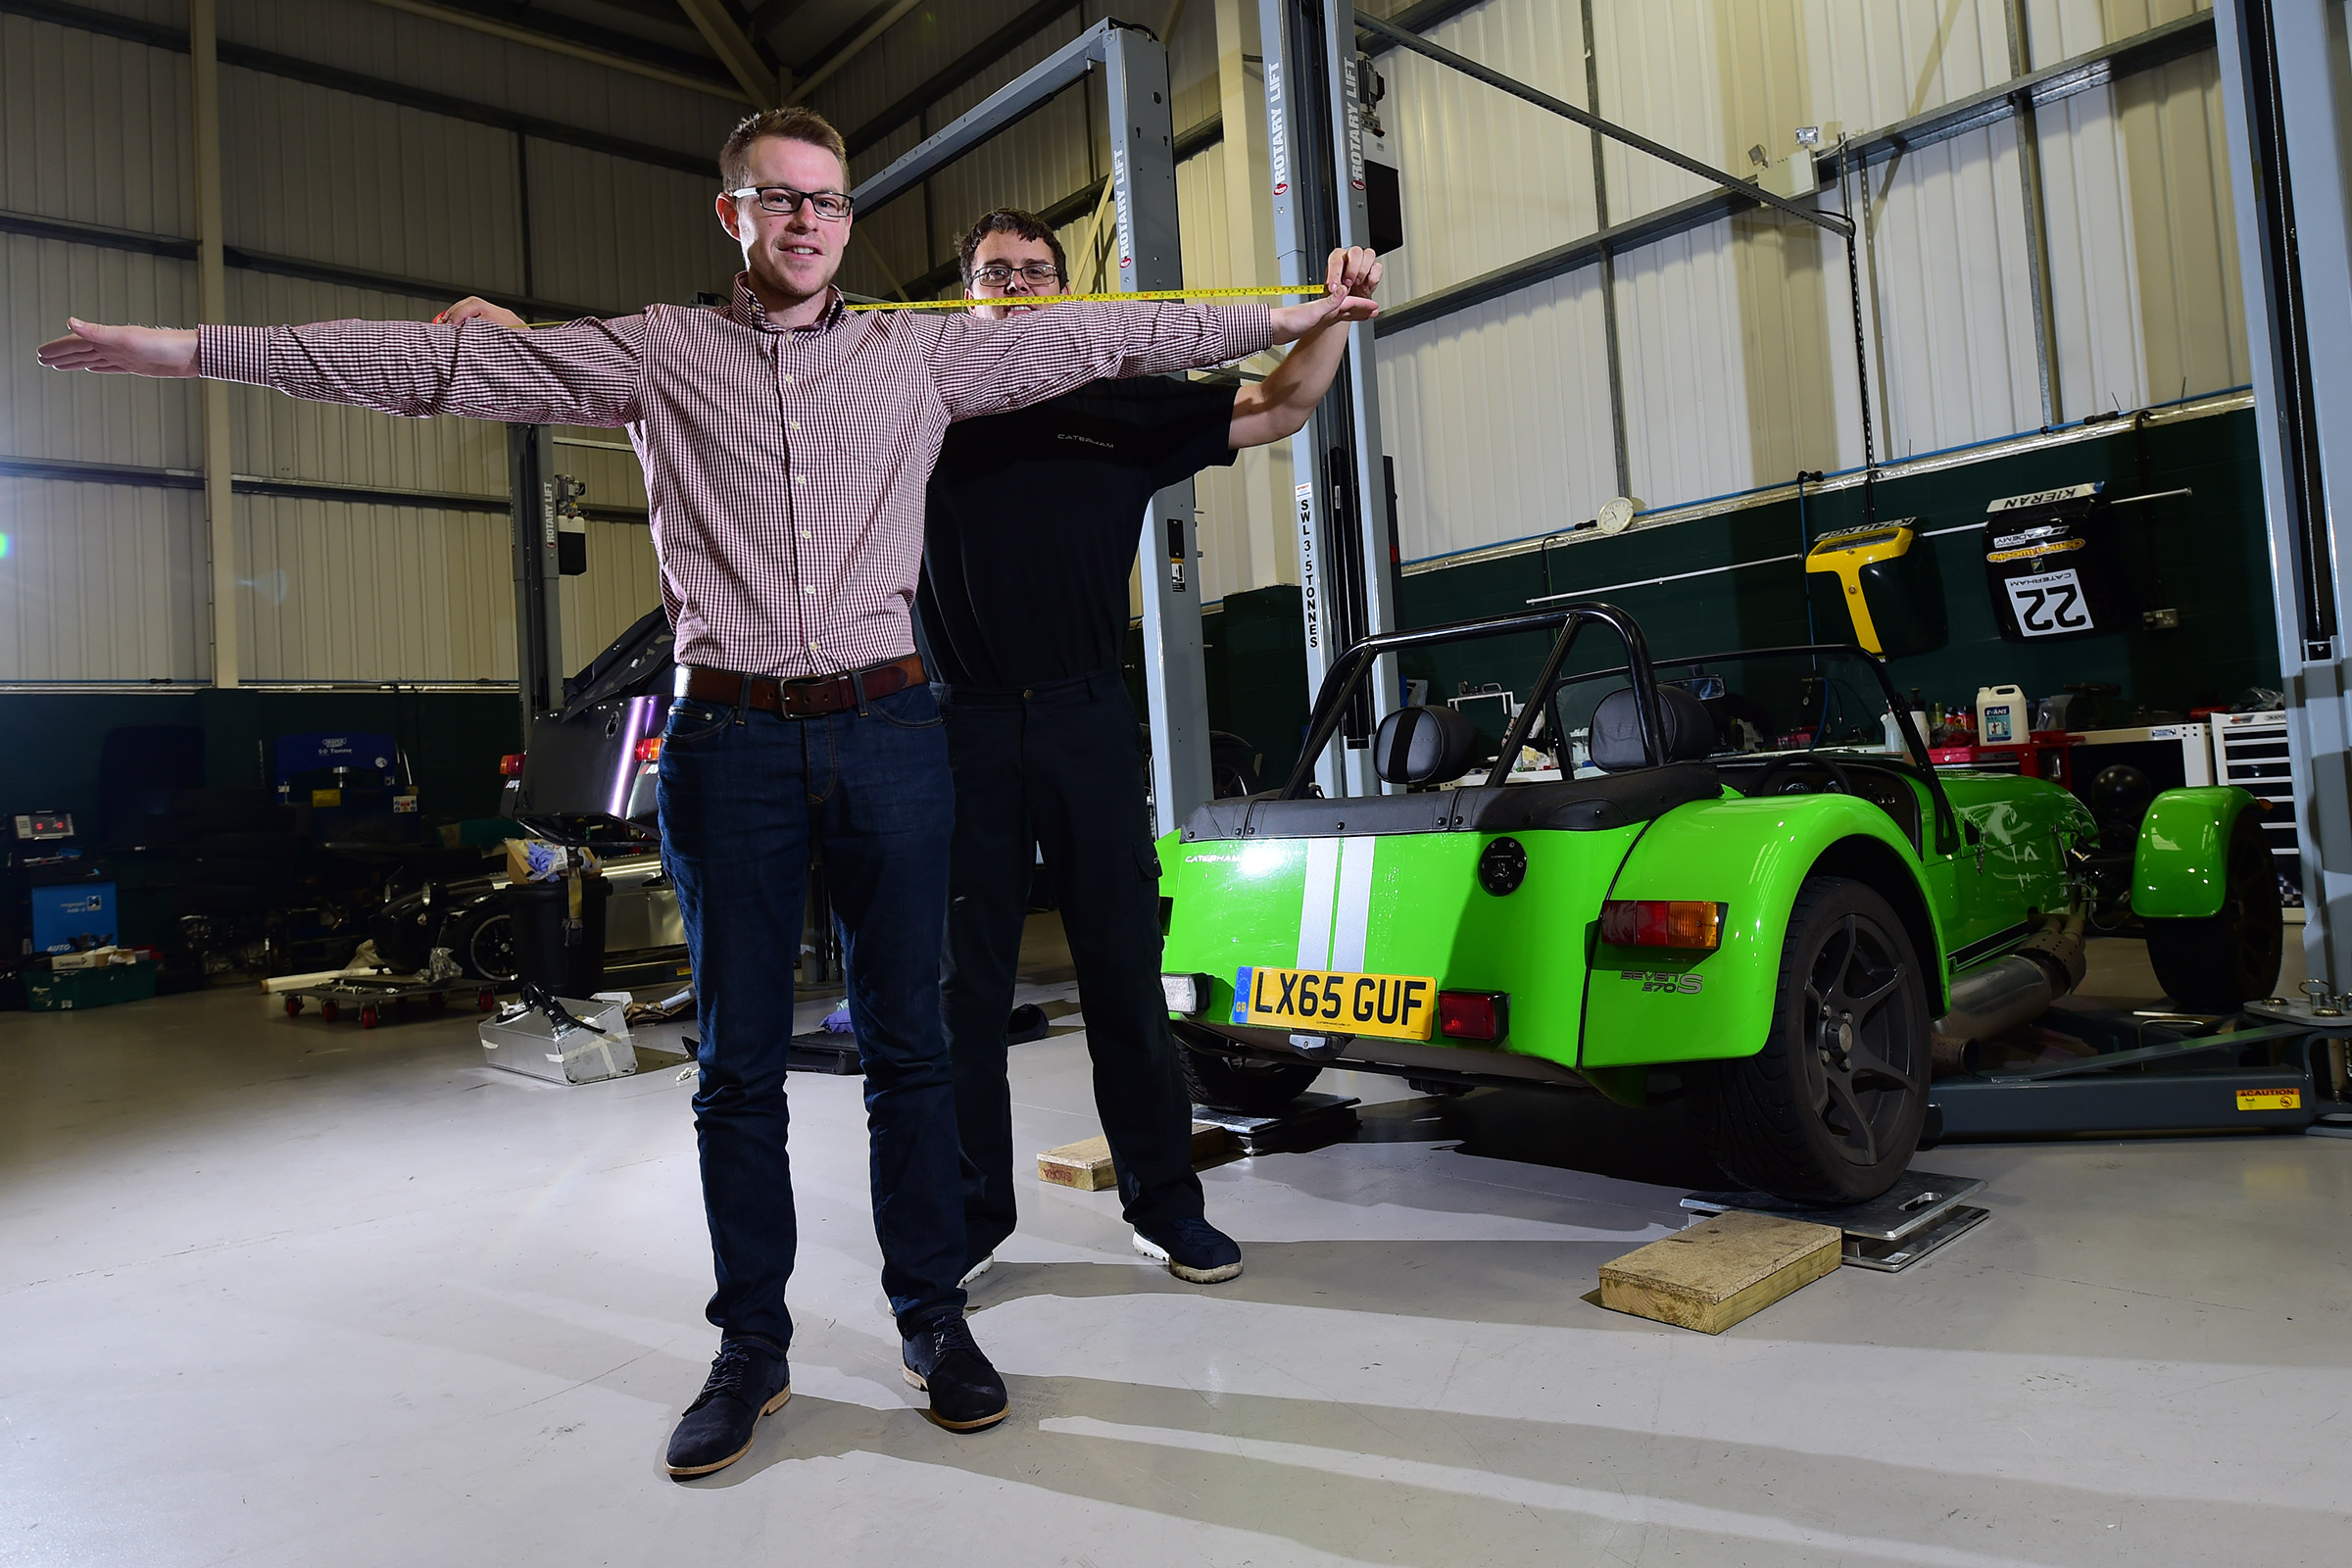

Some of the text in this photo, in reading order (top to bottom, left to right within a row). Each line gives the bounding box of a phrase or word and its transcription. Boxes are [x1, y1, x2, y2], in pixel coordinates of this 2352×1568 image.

[1268, 62, 1286, 184] ROTARY LIFT
[1344, 57, 1363, 180] ROTARY LIFT
[1114, 149, 1129, 259] ROTARY LIFT
[1056, 433, 1114, 449] CATERHAM
[544, 481, 556, 543] ROTARY LIFT
[2004, 488, 2076, 509] KIERAN
[1299, 499, 1311, 535] SWL
[1305, 574, 1318, 648] TONNES
[2010, 572, 2072, 587] CATERHAM
[2015, 583, 2086, 631] 22
[1254, 971, 1427, 1026] LX65 GUF
[1620, 970, 1680, 982] SEVEN
[1235, 1001, 1247, 1013] GB
